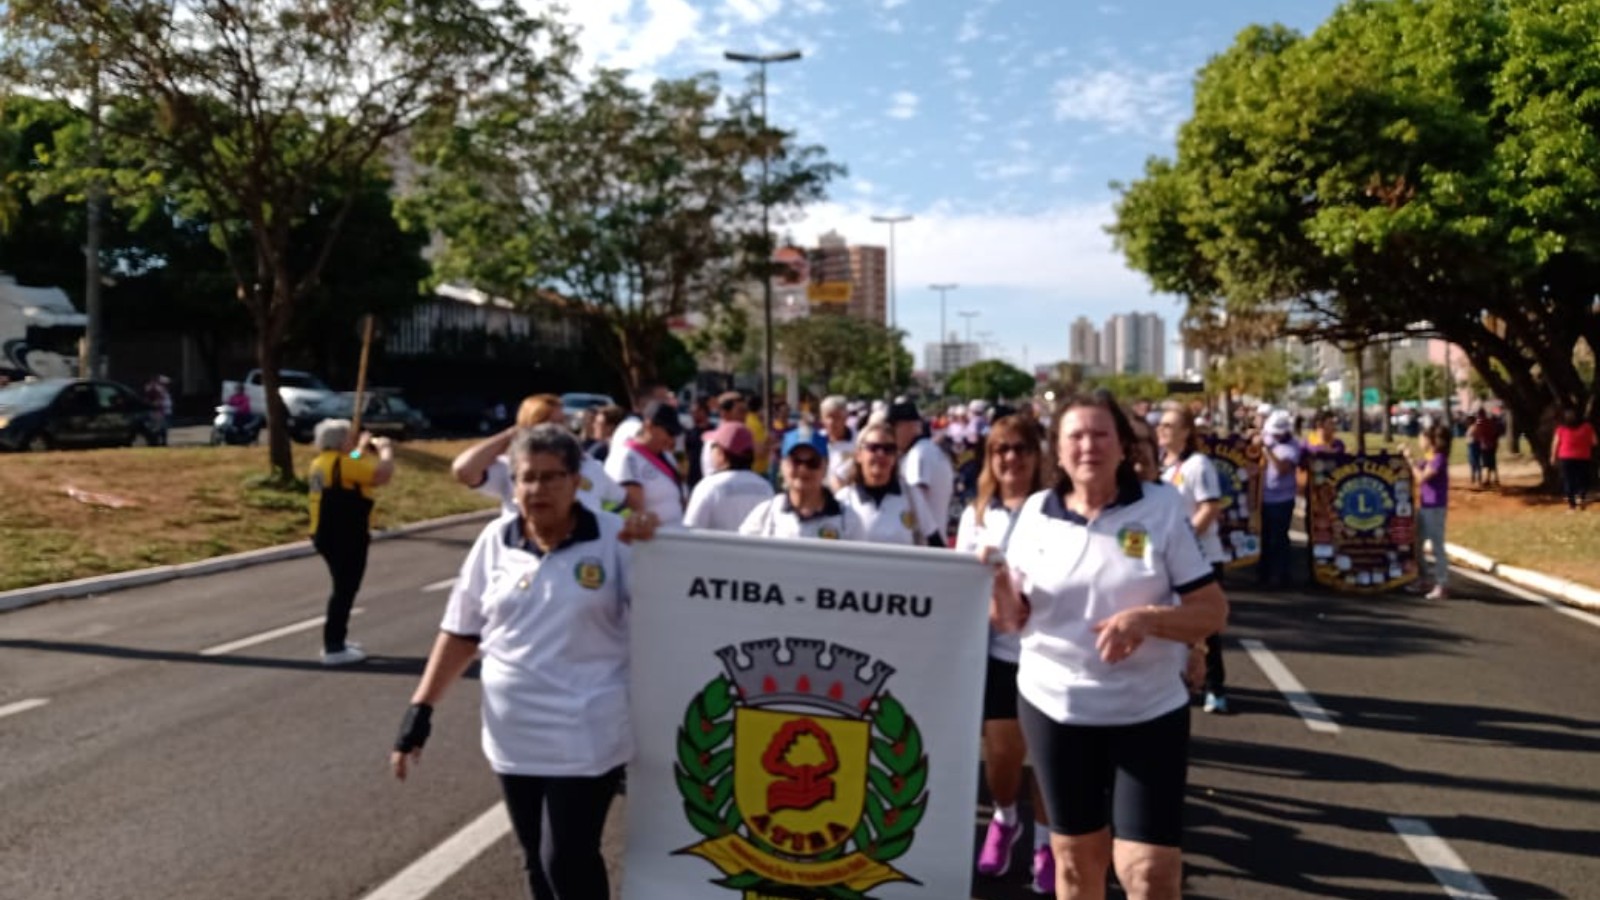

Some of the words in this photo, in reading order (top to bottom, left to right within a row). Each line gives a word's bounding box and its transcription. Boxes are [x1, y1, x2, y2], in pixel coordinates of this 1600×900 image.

[688, 577, 785, 605] ATIBA
[816, 588, 932, 617] BAURU
[750, 814, 850, 851] ATIBA
